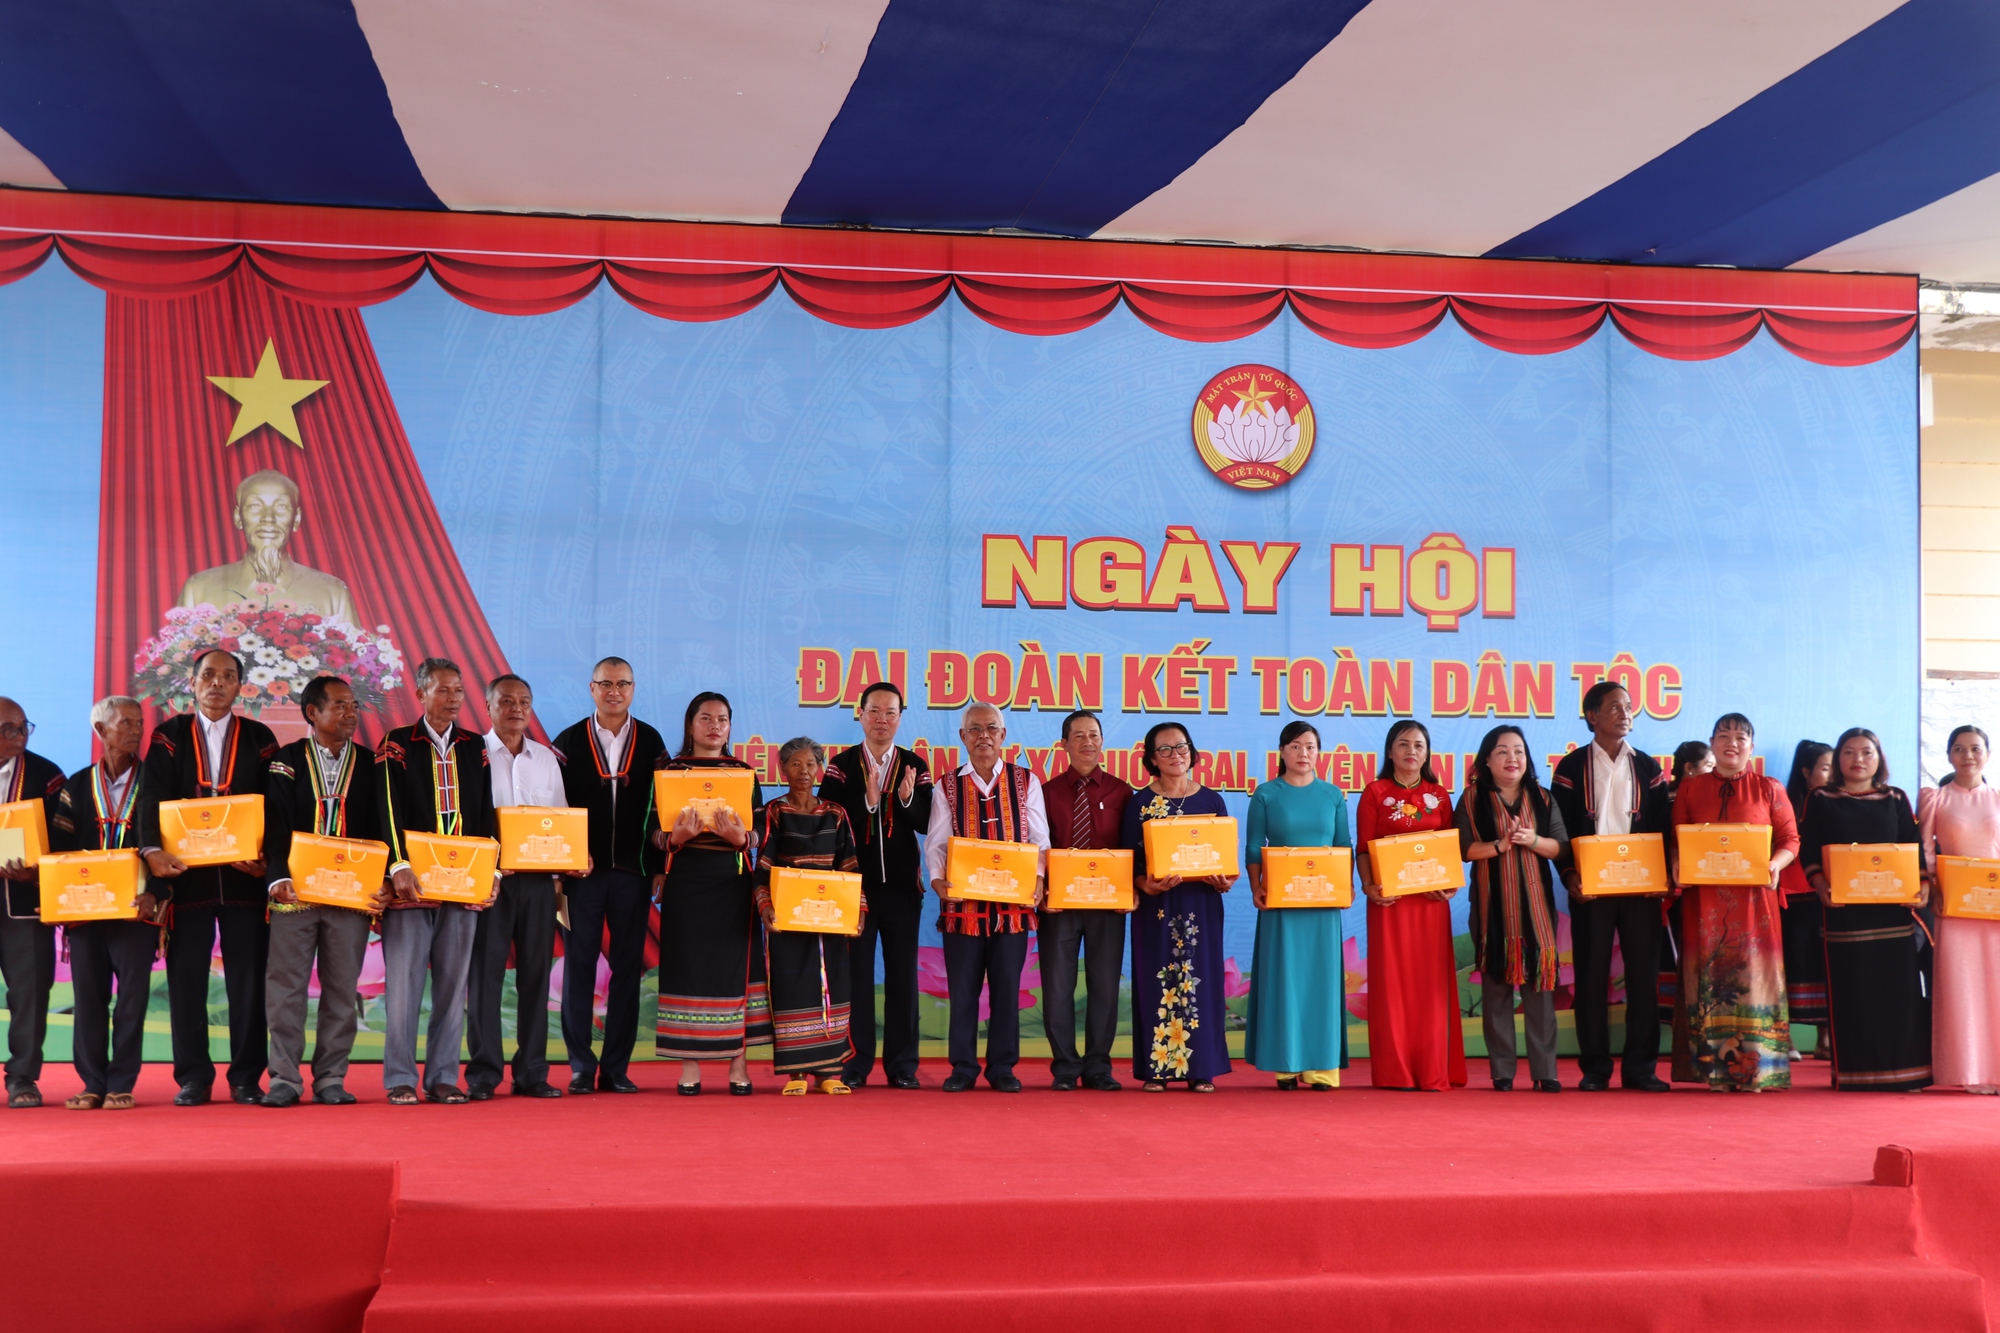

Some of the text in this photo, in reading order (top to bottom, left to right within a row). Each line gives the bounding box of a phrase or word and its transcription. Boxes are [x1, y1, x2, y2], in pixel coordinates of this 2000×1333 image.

[1274, 379, 1299, 401] QUỐC
[1227, 466, 1281, 482] VIỆT NAM
[981, 524, 1515, 632] NGÀY HỘI
[796, 647, 908, 721] ĐẠI
[925, 639, 1103, 712] ĐOÀN
[1122, 638, 1237, 714] KẾT
[1251, 646, 1413, 717] TOÀN
[1431, 649, 1555, 719] DÂN
[893, 737, 960, 787] ÂN
[1186, 749, 1258, 797] RAI,
